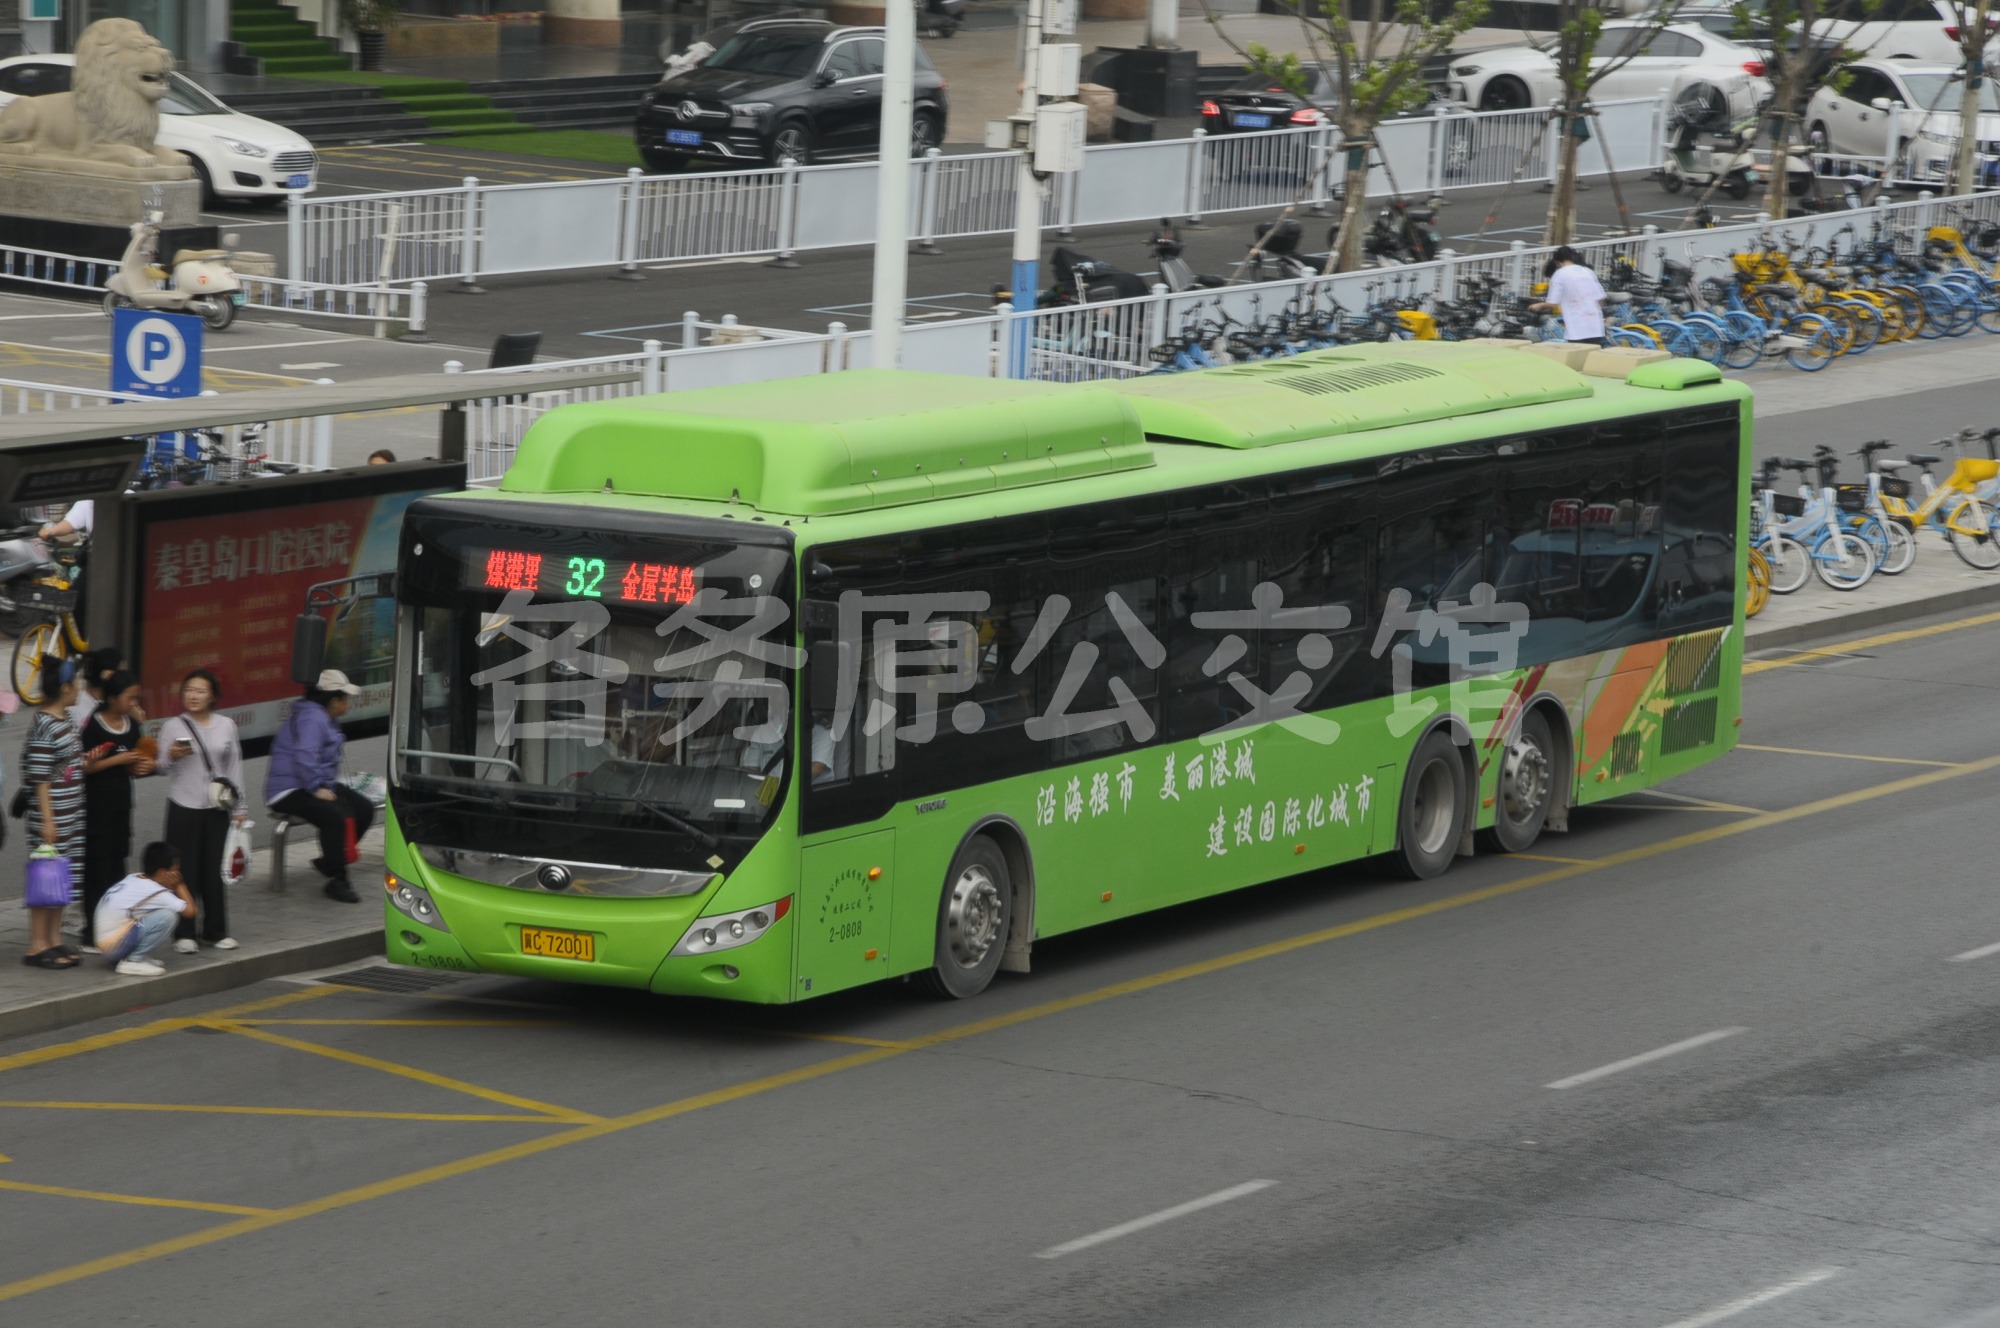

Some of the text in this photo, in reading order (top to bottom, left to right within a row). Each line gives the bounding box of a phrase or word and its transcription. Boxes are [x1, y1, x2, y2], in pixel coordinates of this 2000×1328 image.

[143, 331, 171, 372] P
[155, 521, 351, 591] 秦皇岛口腔医院
[565, 557, 605, 597] 32
[620, 562, 696, 604] 金屋半岛
[1036, 739, 1256, 827] 沿海强市 美丽港城
[1206, 773, 1375, 859] 建设国际化城市
[829, 920, 862, 943] 2-0808
[411, 951, 467, 970] 2-0808
